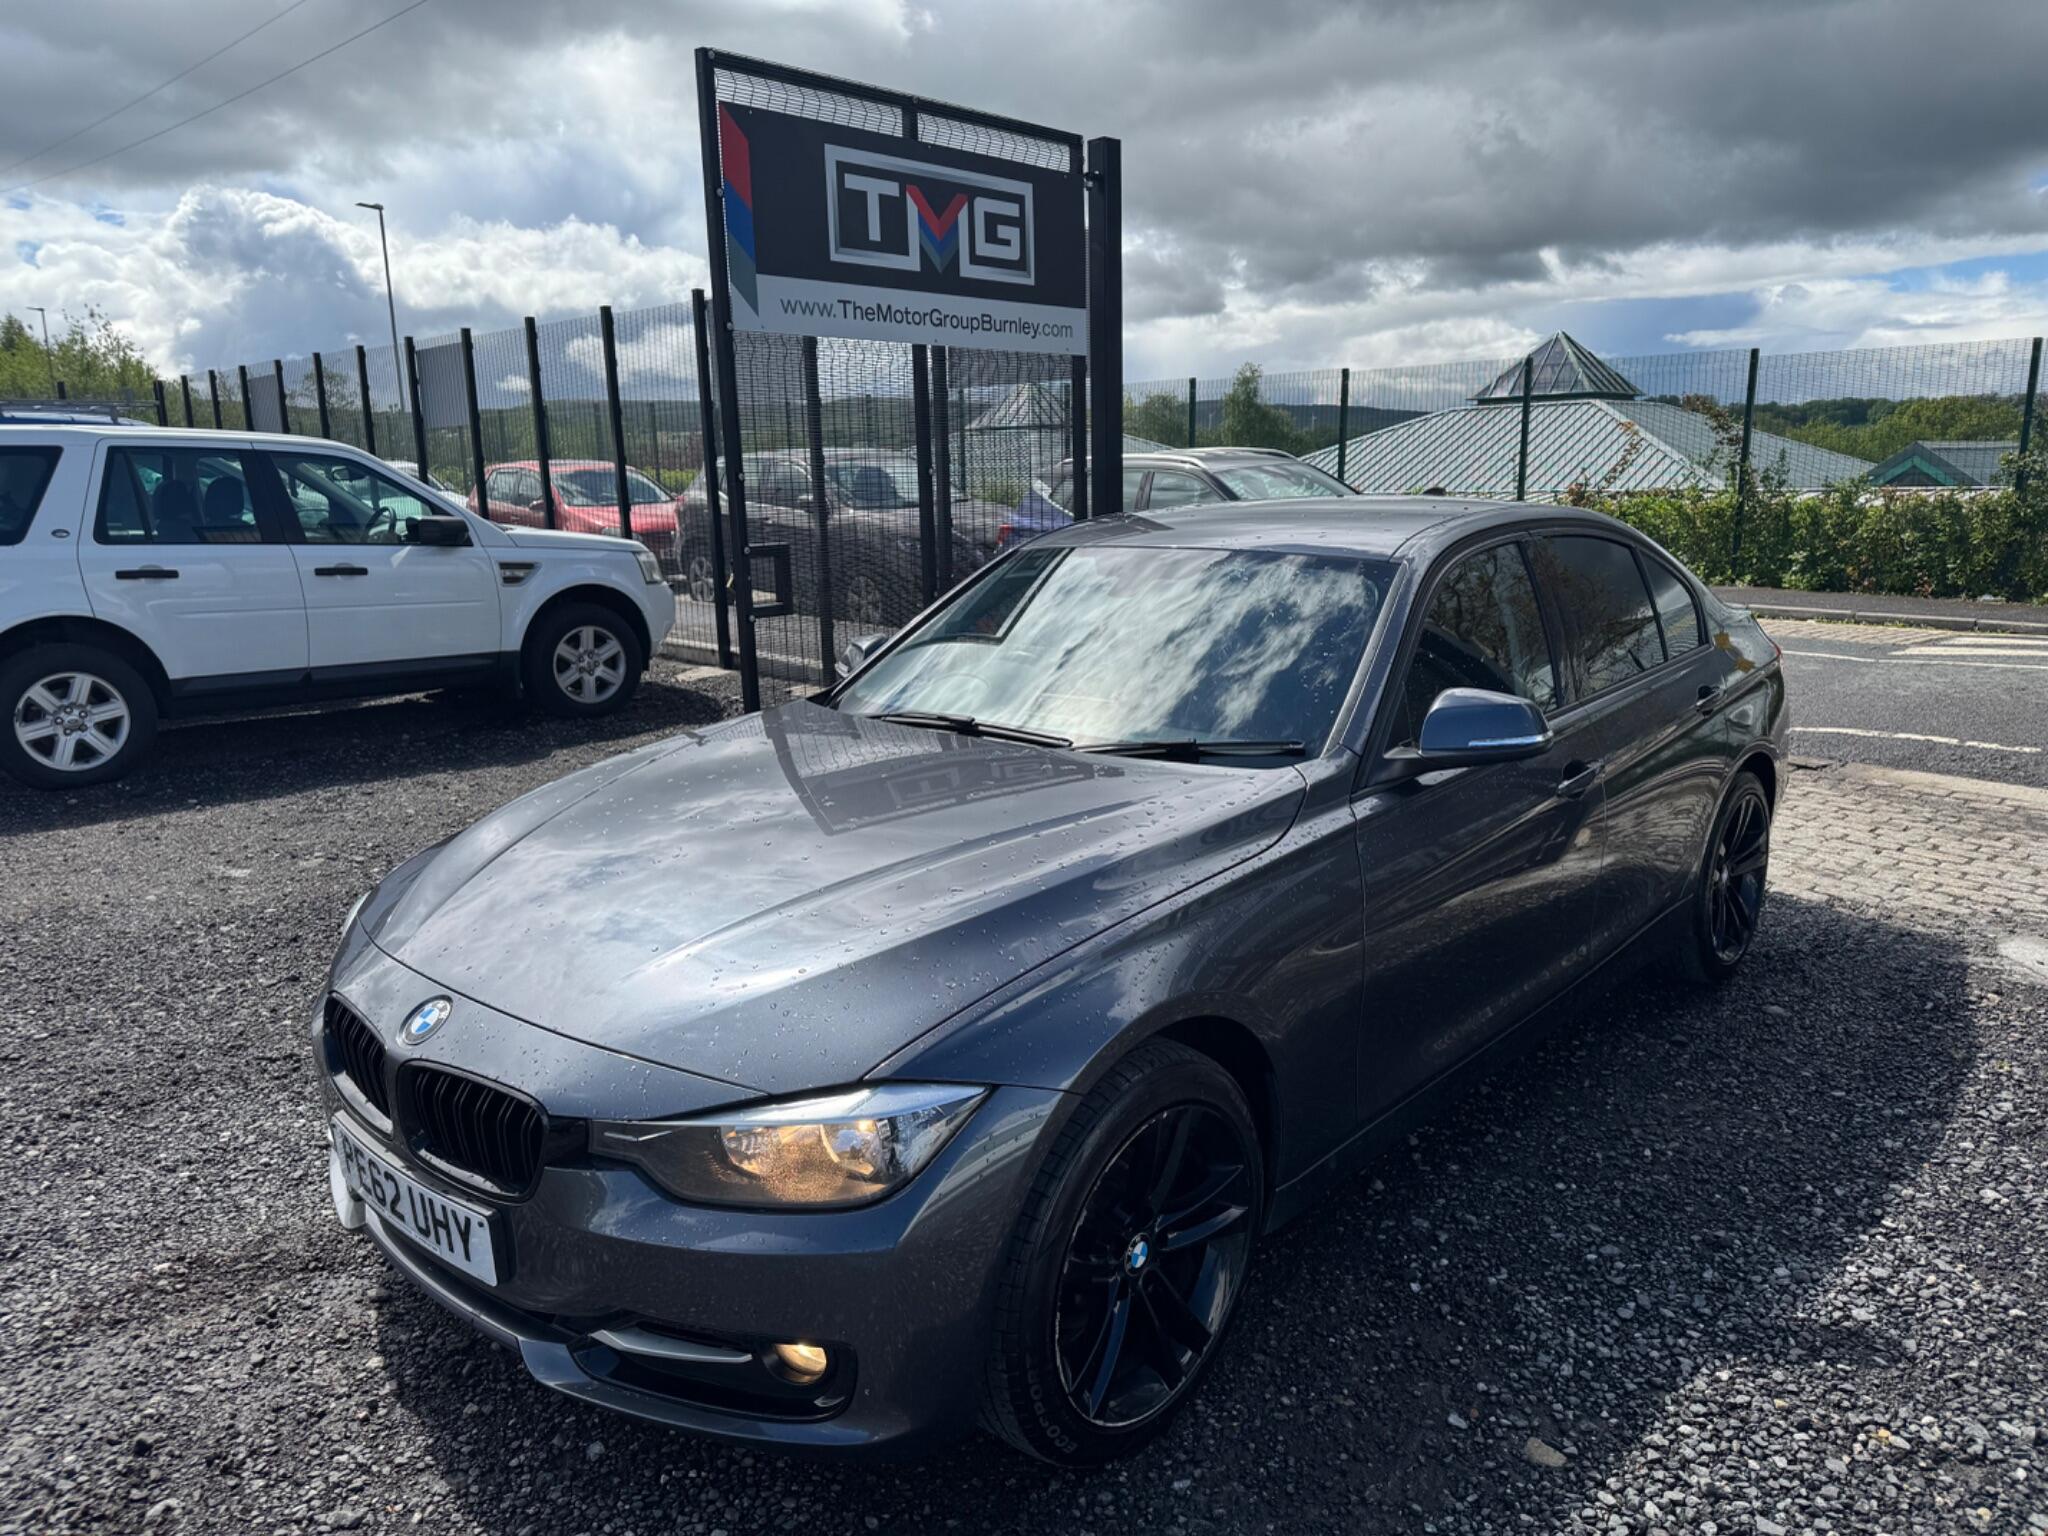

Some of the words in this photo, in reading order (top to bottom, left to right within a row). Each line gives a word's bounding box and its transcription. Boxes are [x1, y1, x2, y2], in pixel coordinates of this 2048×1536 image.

[844, 172, 1021, 273] TMG
[779, 298, 1073, 338] www.TheMotorGroupBurnley.com
[342, 1134, 405, 1223] PE62
[408, 1184, 473, 1263] UHY
